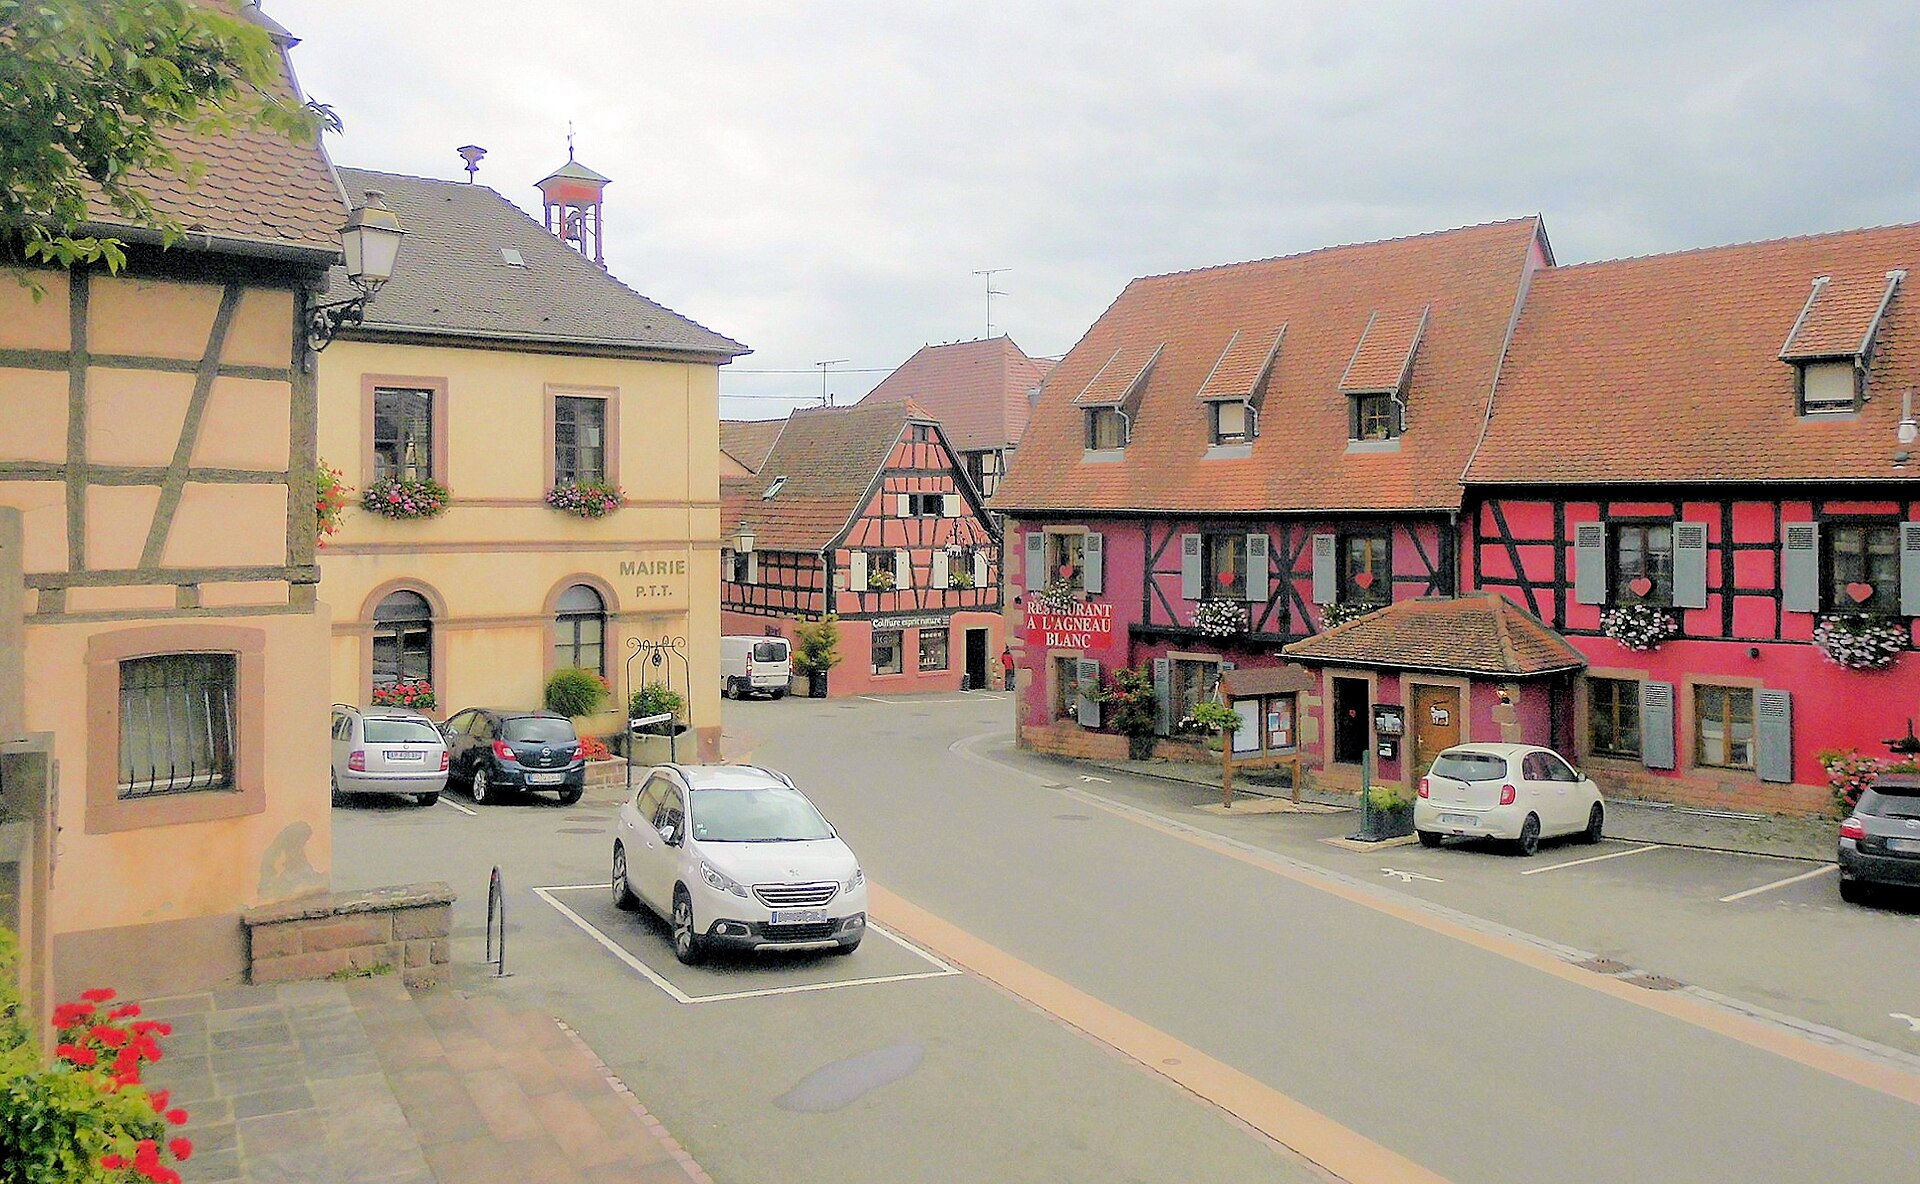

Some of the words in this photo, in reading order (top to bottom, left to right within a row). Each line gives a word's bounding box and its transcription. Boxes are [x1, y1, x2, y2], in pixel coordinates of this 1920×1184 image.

[620, 560, 685, 575] MAIRIE
[636, 585, 673, 597] P.T.T.
[1027, 616, 1036, 629] A
[1042, 616, 1111, 632] L'AGNEAU
[1046, 632, 1091, 648] BLANC
